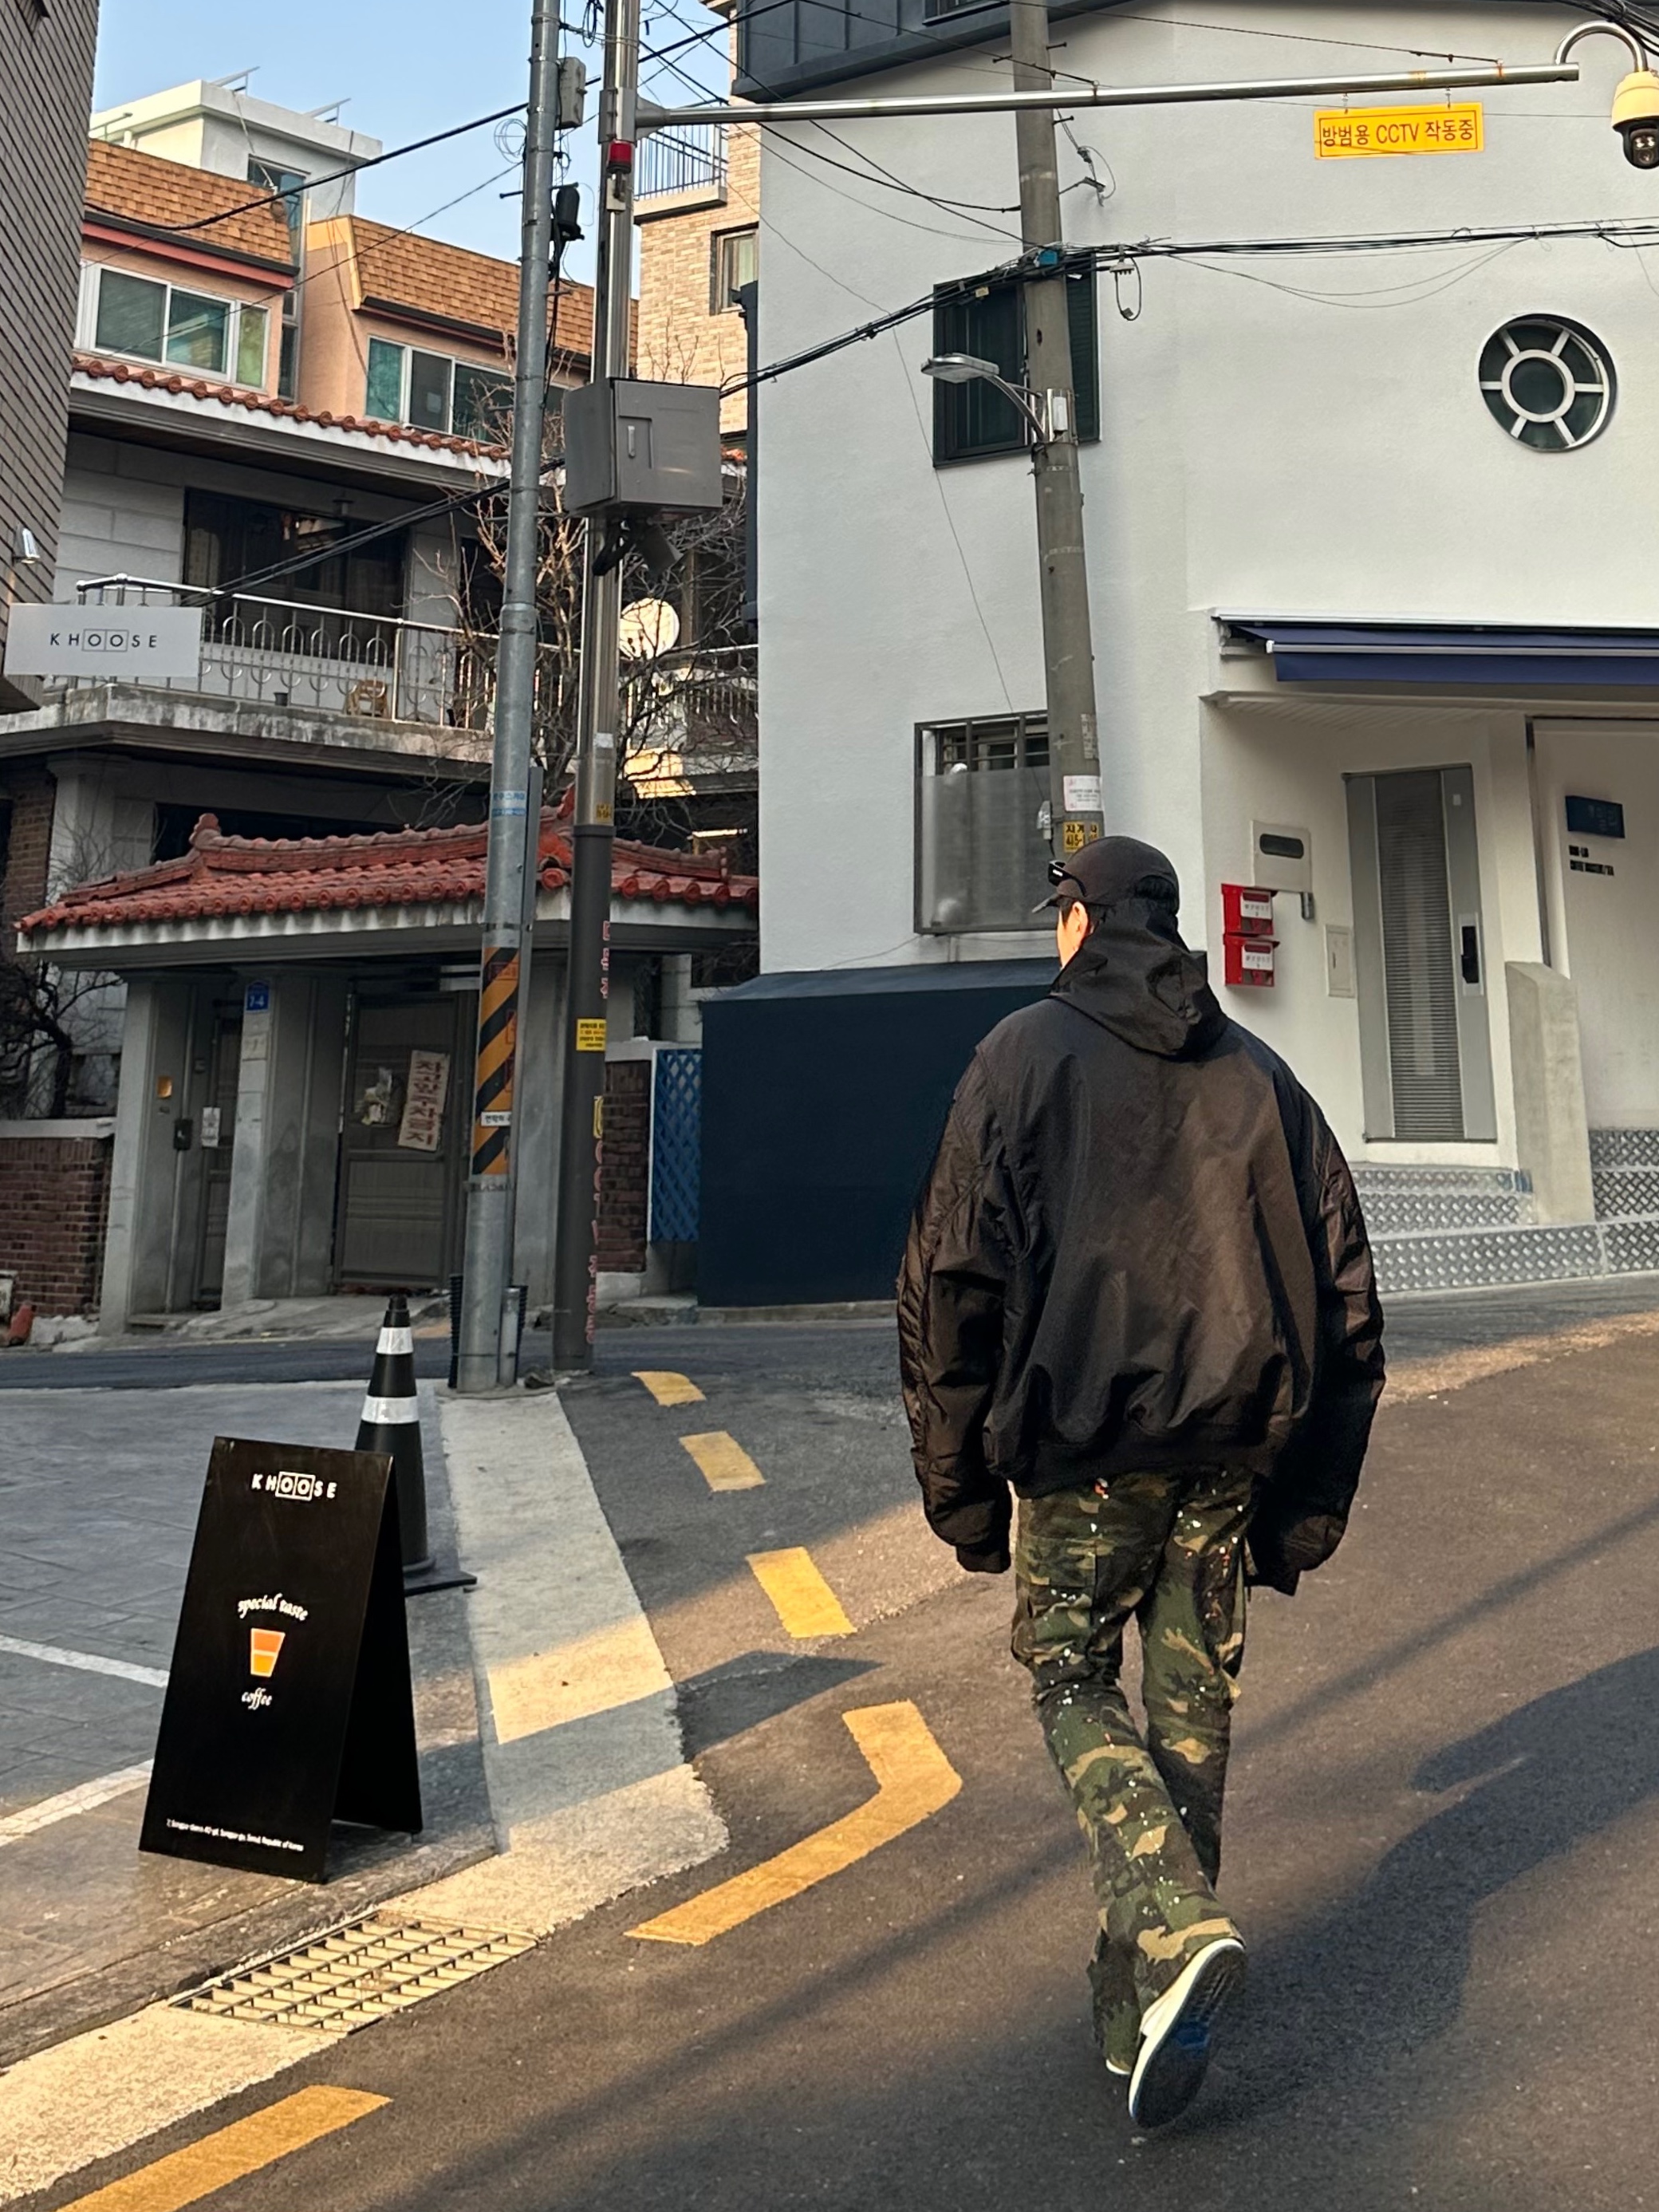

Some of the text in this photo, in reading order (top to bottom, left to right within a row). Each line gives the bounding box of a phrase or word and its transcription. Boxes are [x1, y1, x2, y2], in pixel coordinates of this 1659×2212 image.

[1322, 118, 1474, 148] 방범용 CCTV 작동중
[49, 631, 158, 649] KHOOSE
[251, 1473, 337, 1500] KHOOSE
[237, 1592, 309, 1622] special taste
[241, 1687, 273, 1711] coffee
